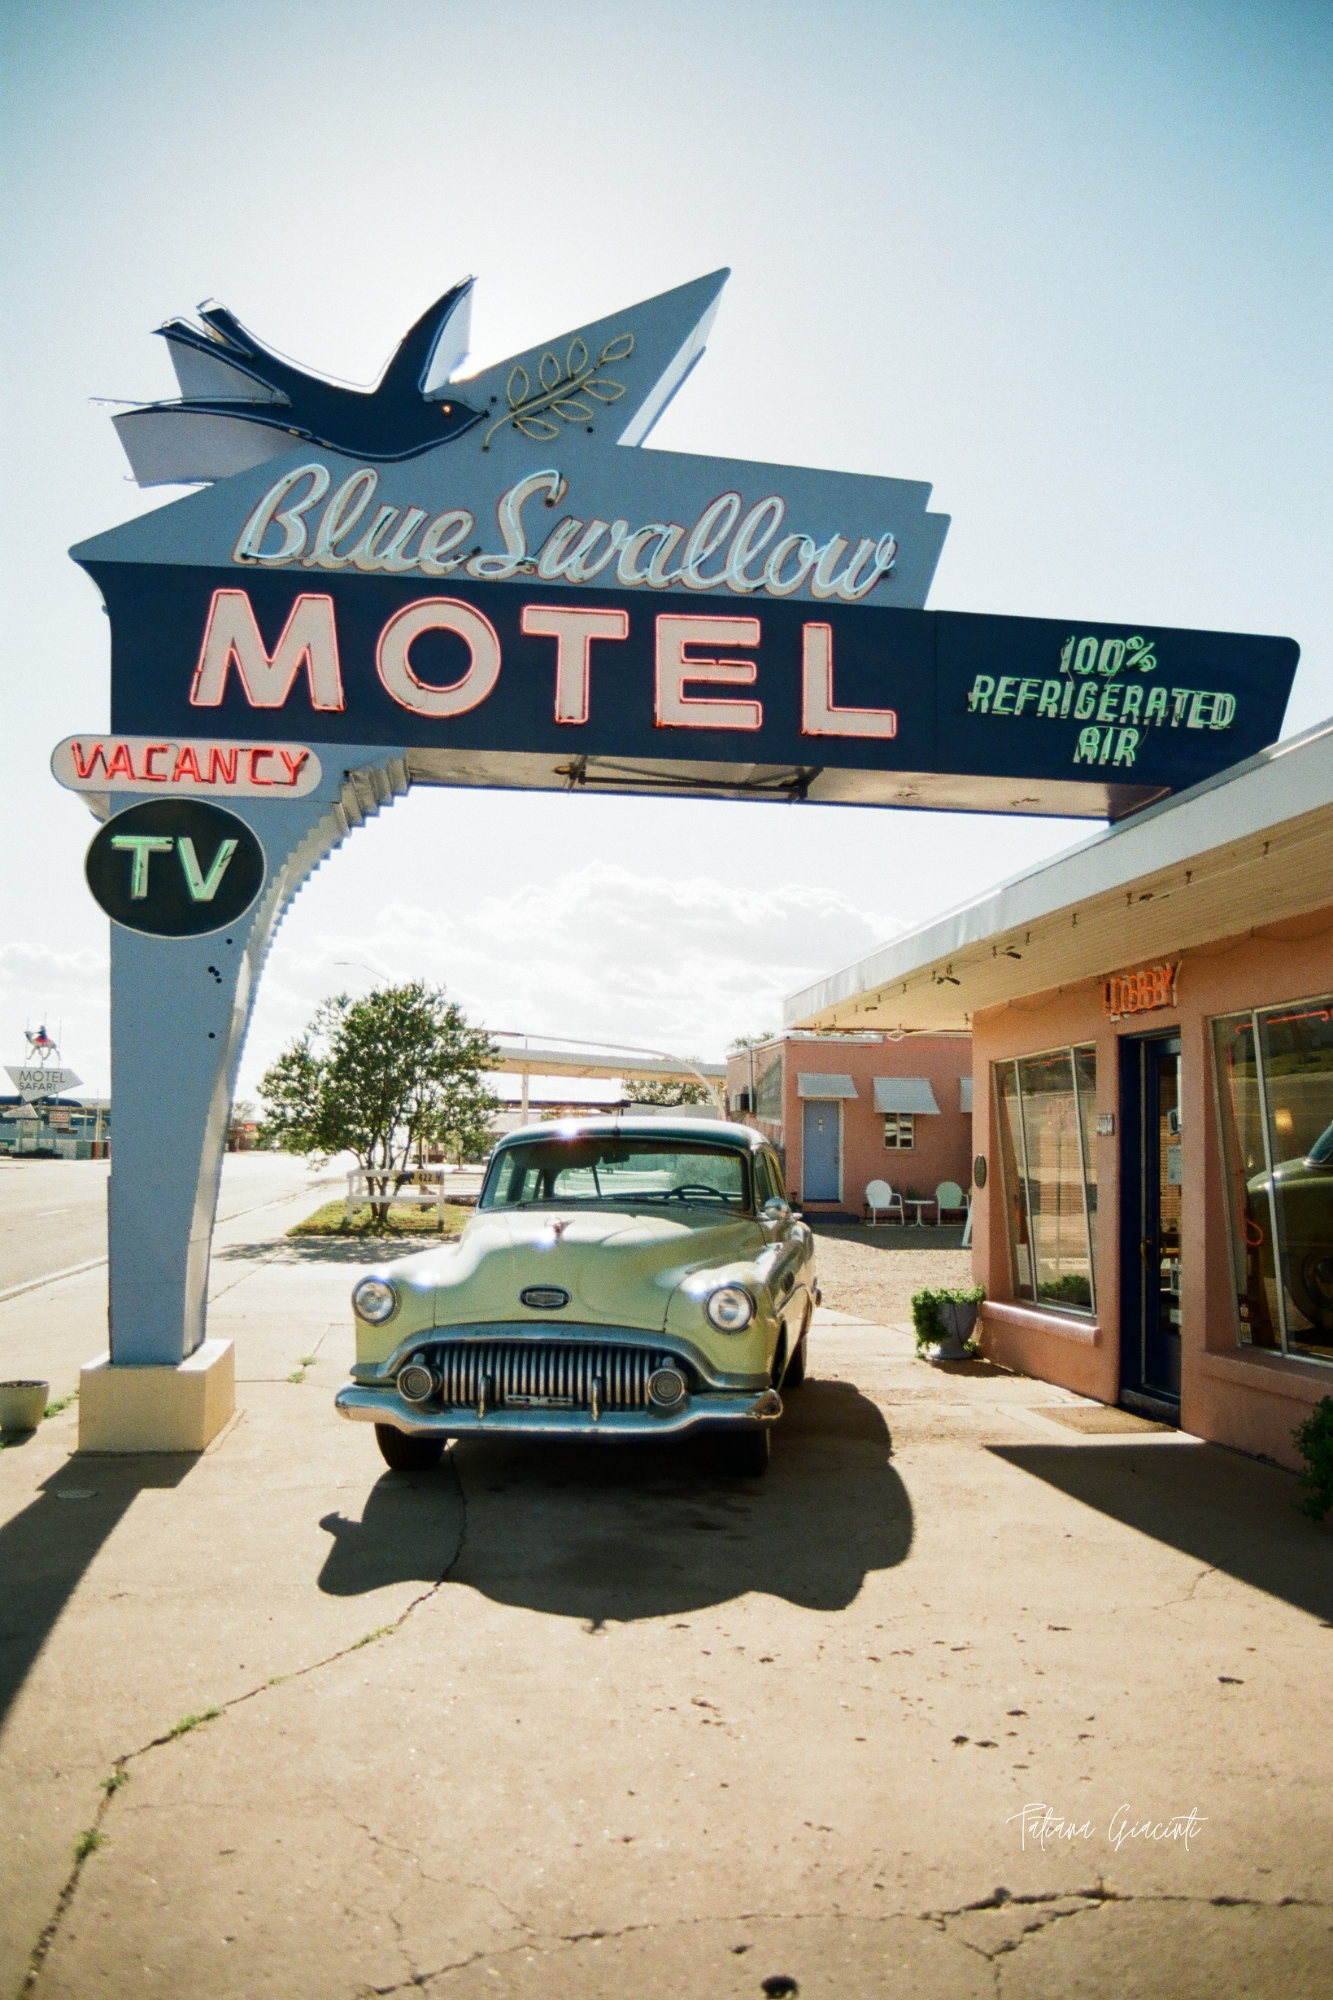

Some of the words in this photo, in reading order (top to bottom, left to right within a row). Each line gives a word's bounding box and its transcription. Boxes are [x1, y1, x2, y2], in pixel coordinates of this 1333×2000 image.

[231, 463, 480, 576] Blue
[466, 469, 898, 601] Swallow
[189, 588, 897, 738] MOTEL
[1060, 636, 1157, 676] 100%
[967, 674, 1236, 730] REFRIGERATED
[71, 741, 309, 786] VACANCY
[1073, 727, 1139, 767] AIR
[110, 835, 239, 901] TV
[1103, 966, 1179, 1021] LOBBY
[19, 1070, 66, 1083] MOTEL
[19, 1082, 57, 1091] SAFARI
